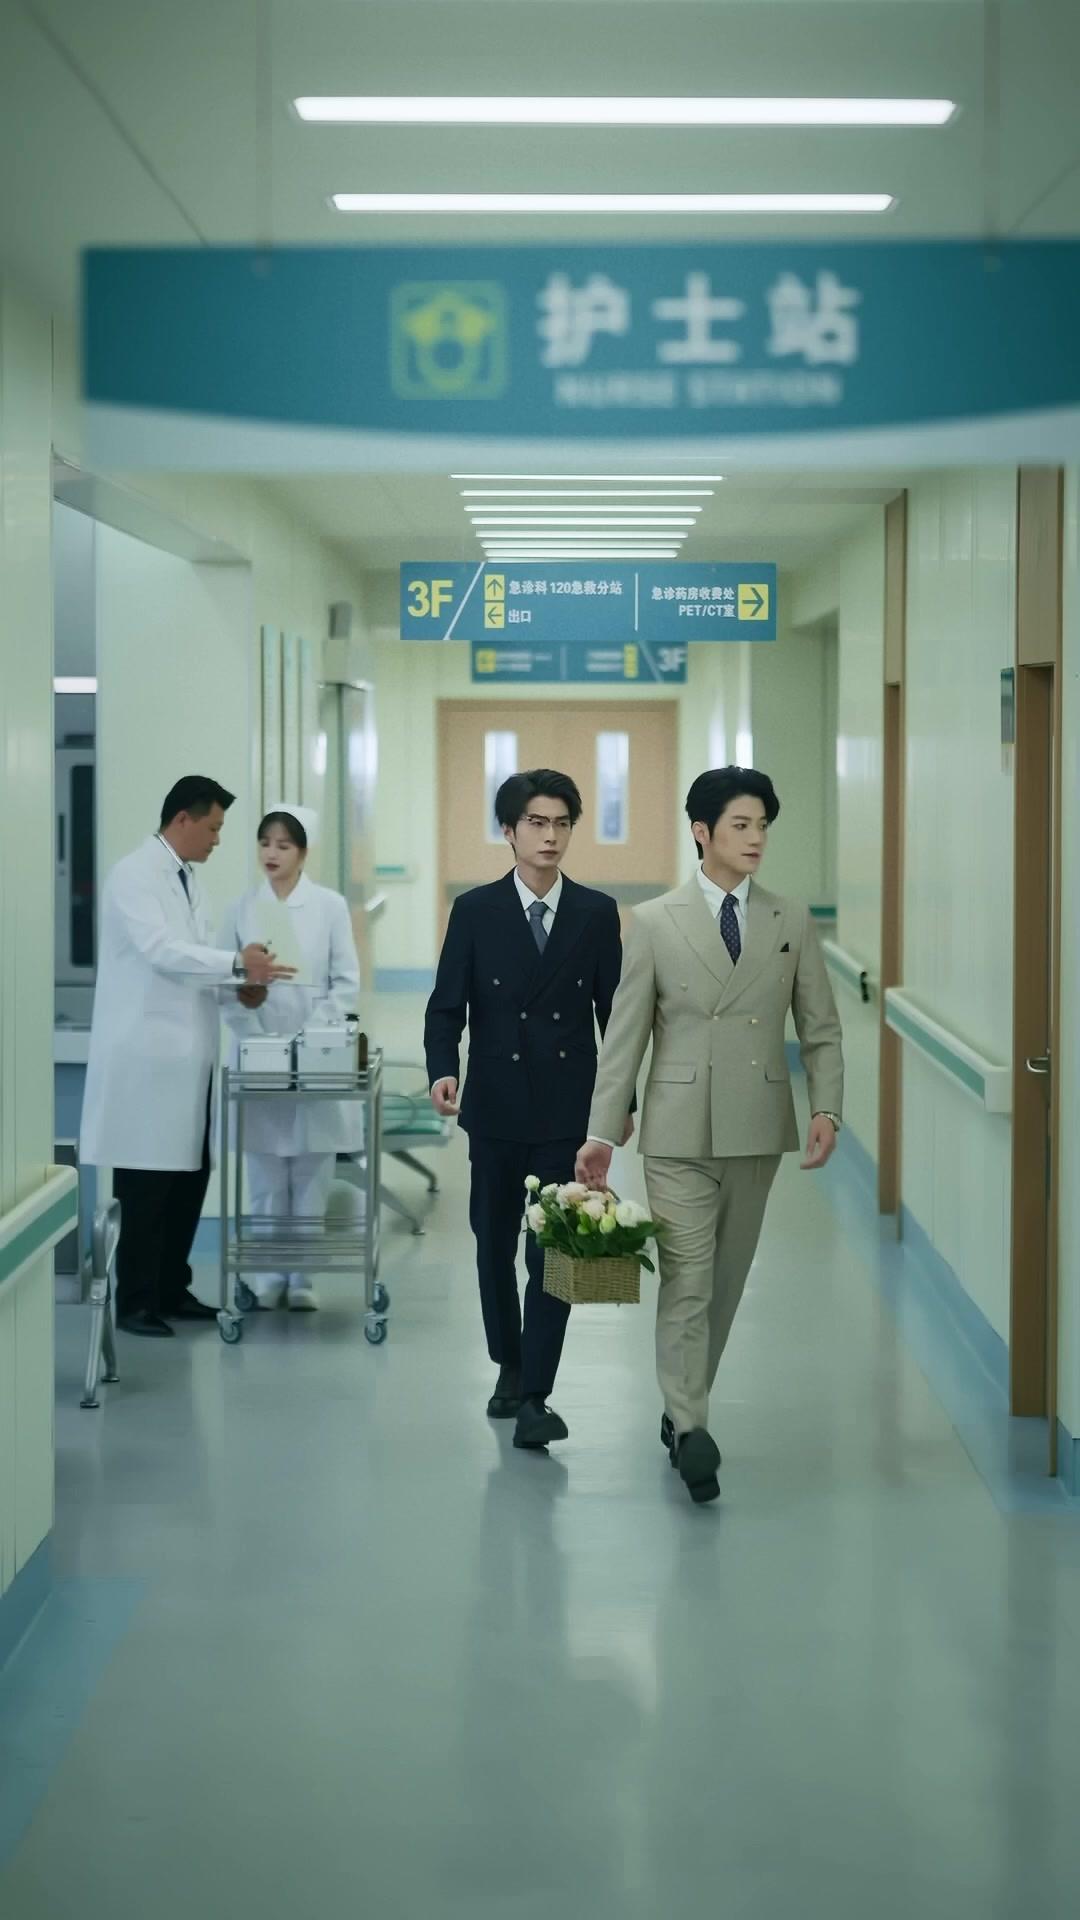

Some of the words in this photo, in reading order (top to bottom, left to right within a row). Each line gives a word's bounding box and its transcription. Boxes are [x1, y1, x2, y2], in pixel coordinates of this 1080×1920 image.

[537, 271, 861, 367] 护士站
[509, 580, 547, 595] 急诊科
[652, 586, 735, 600] 急诊药房收费处
[408, 580, 453, 617] 3F
[508, 609, 532, 623] 出口
[679, 604, 736, 618] PET/CT室
